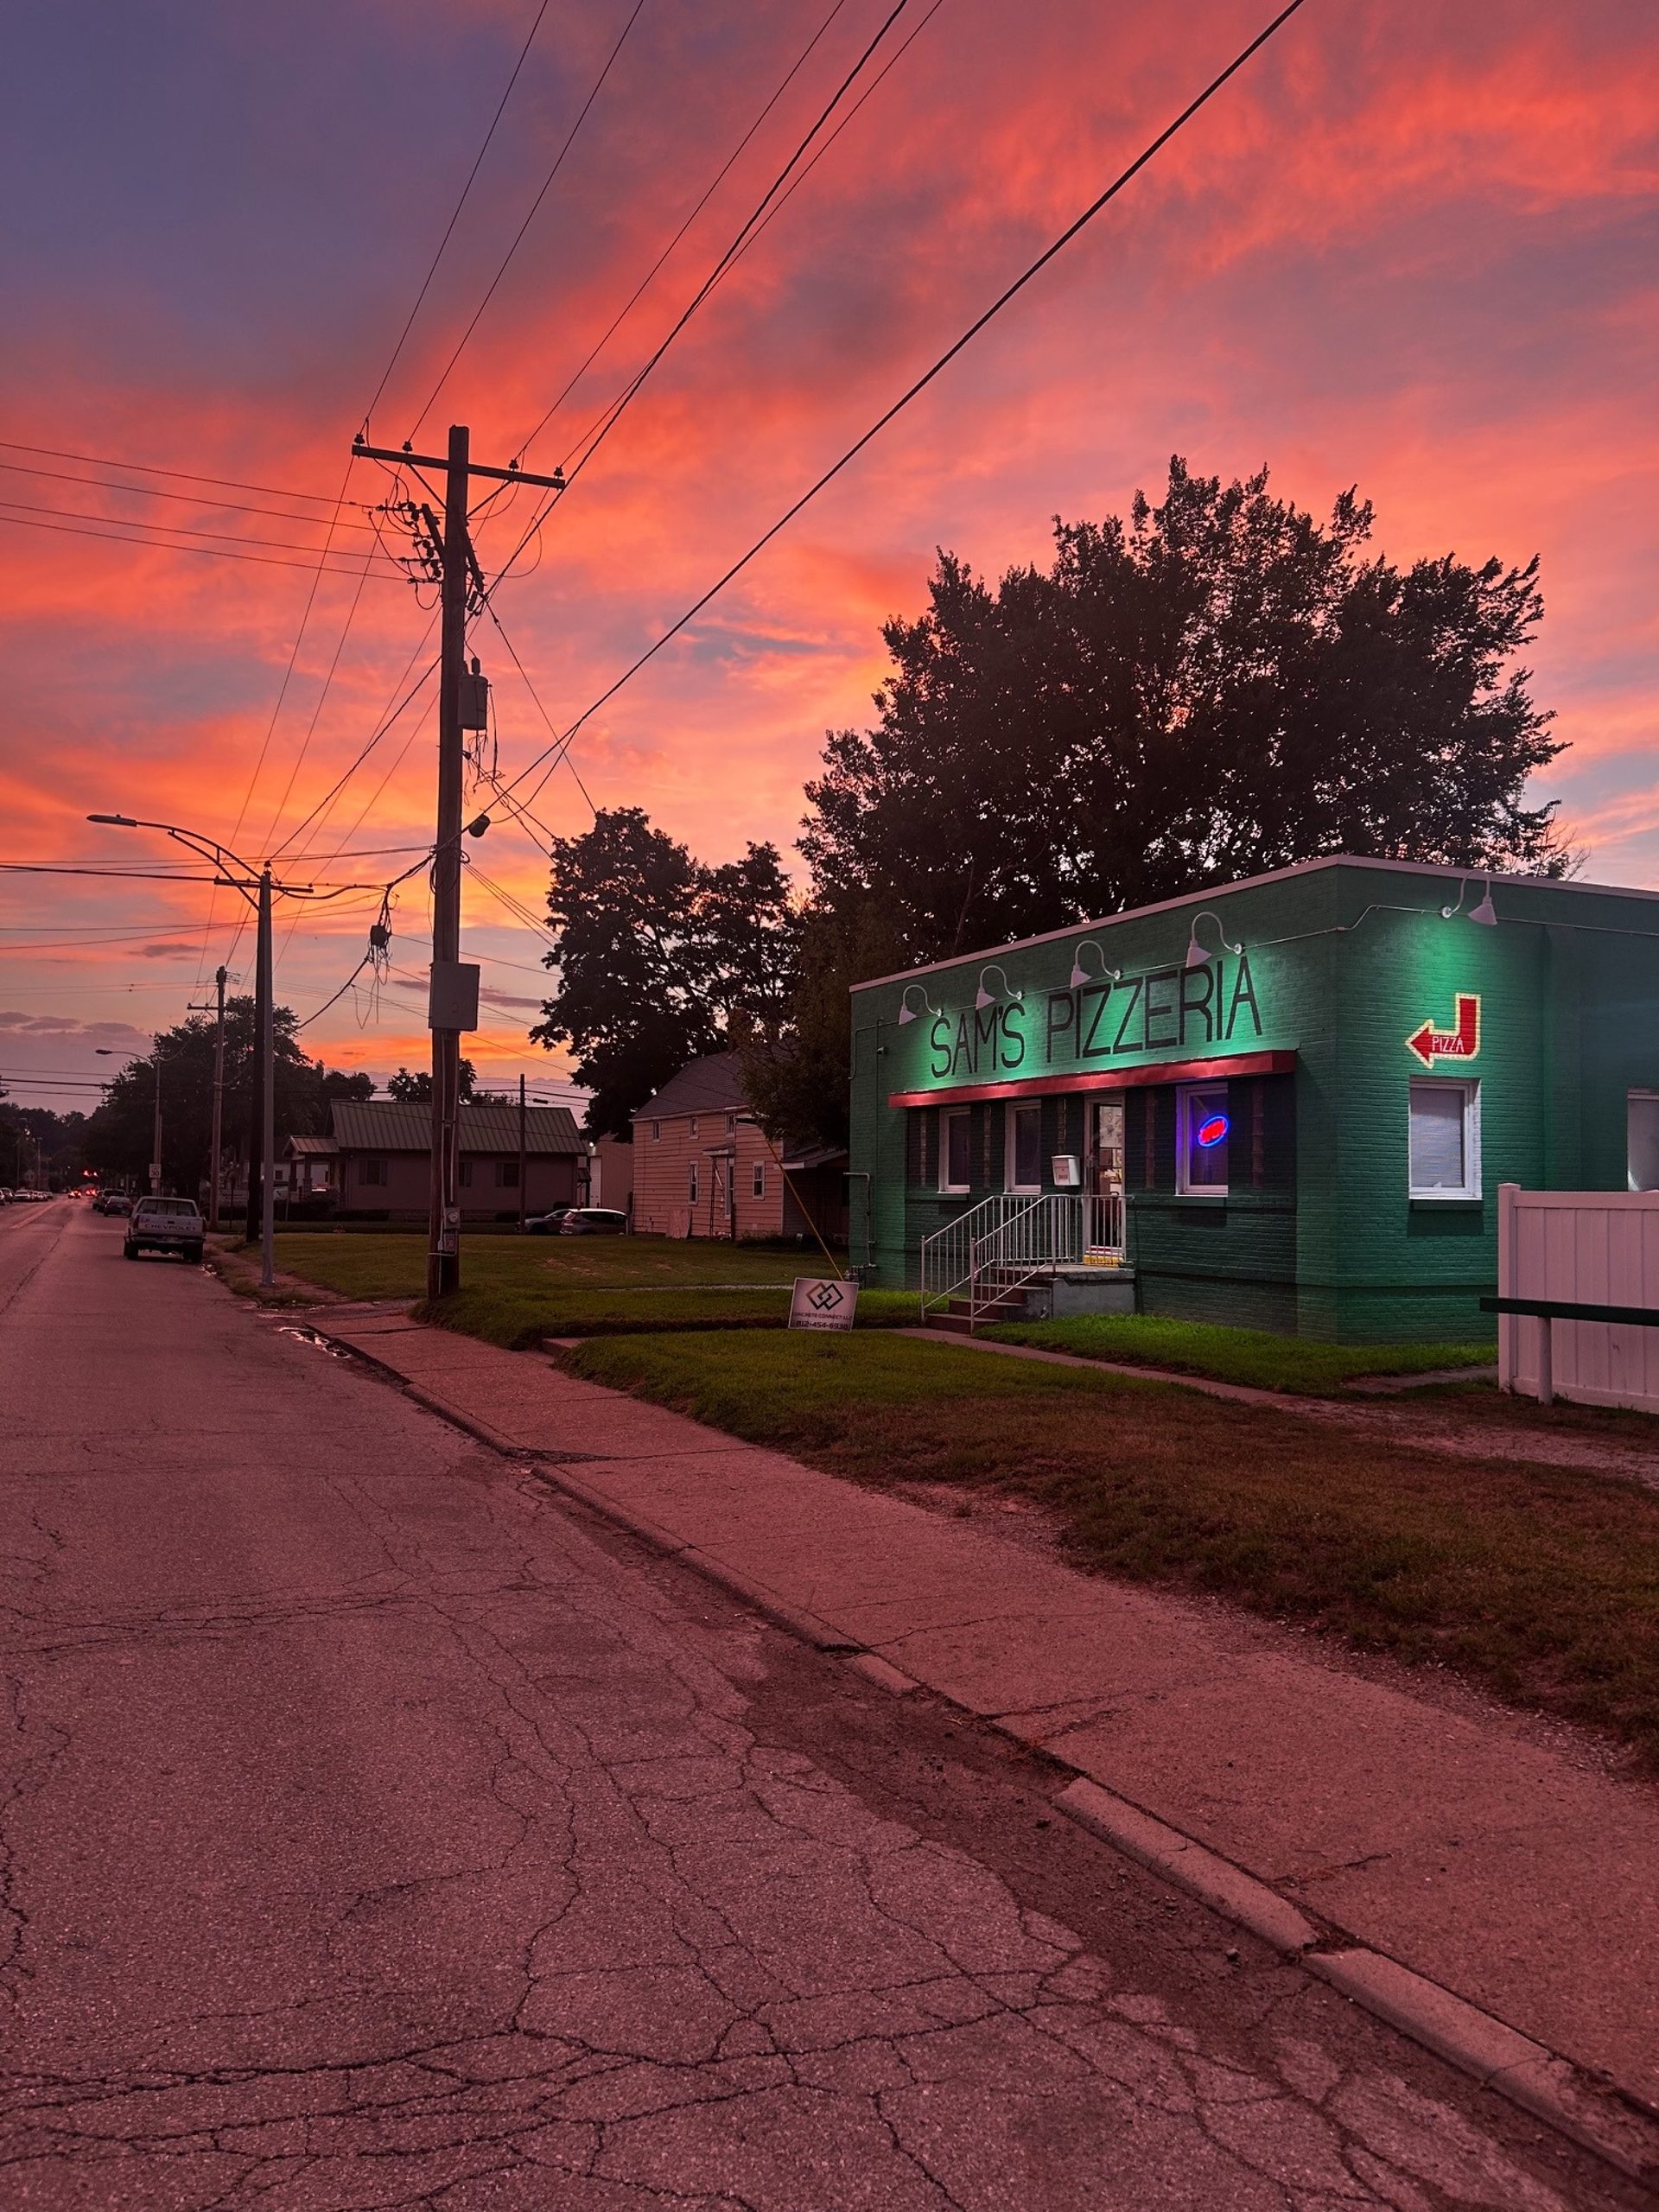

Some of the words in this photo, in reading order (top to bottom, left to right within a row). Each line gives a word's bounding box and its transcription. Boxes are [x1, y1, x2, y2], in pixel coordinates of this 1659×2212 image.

[931, 1002, 1026, 1078] SAM'S
[1046, 956, 1263, 1064] PIZZERIA
[1432, 1036, 1465, 1053] PIZZA
